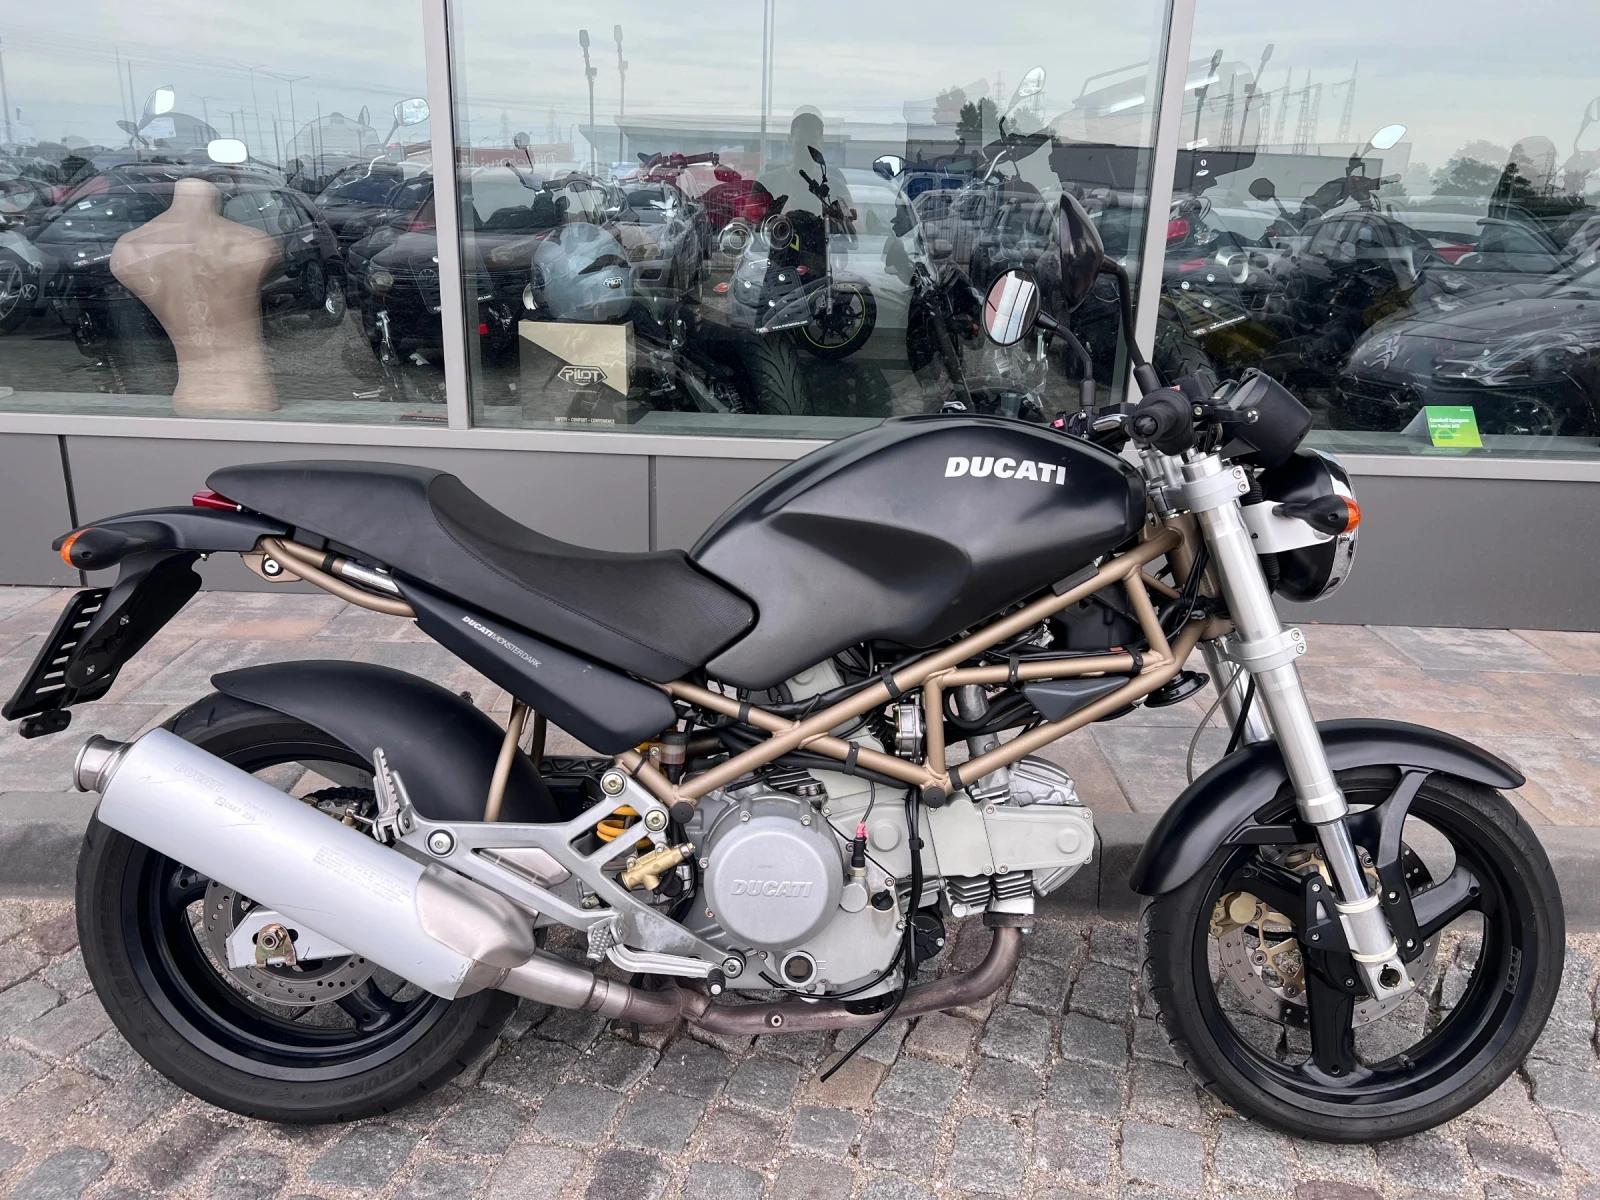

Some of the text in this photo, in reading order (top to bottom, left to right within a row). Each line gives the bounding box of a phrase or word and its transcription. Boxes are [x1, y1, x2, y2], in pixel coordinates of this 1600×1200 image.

[944, 456, 1066, 485] DUCATI
[174, 763, 226, 791] DUCATI
[730, 879, 813, 898] DUCATI
